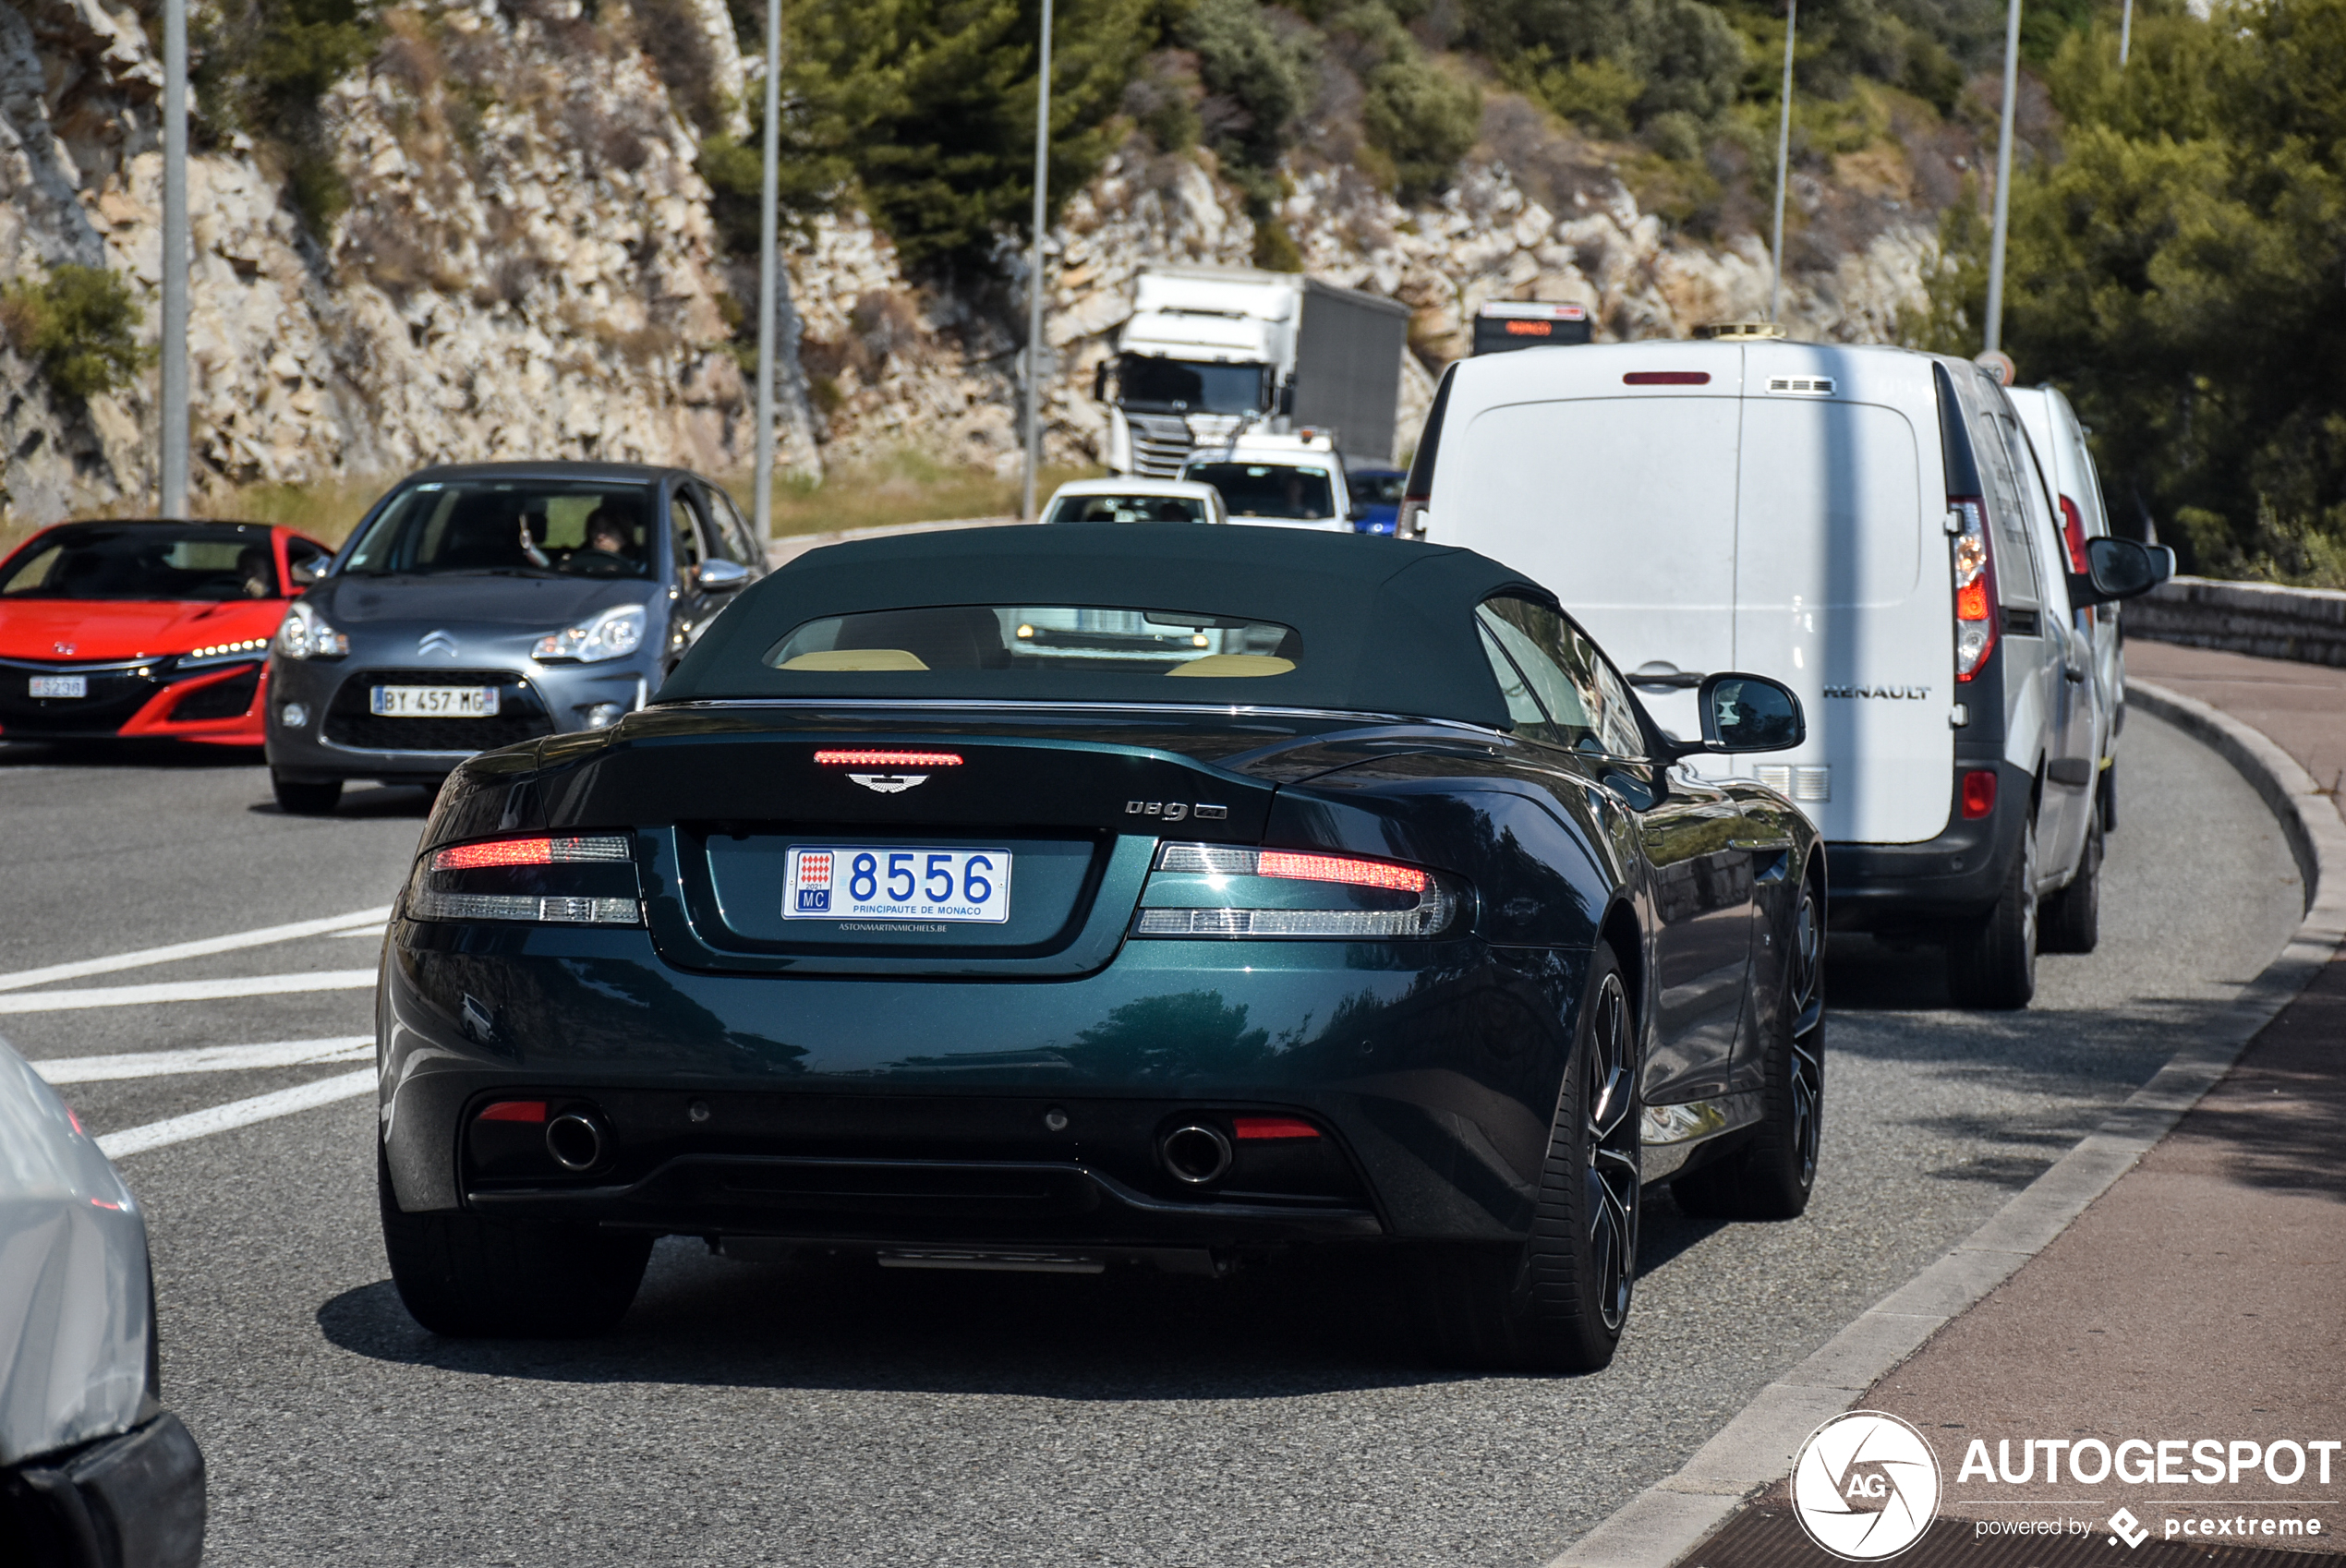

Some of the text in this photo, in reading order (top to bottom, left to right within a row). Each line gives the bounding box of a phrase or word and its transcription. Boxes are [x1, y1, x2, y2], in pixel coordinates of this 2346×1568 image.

[1822, 684, 1931, 700] RENAULT
[1124, 801, 1189, 821] DB9
[849, 852, 994, 904] 8556
[803, 892, 825, 907] MC
[853, 905, 982, 915] PRINCIPAUTE DE MONACO
[839, 923, 948, 933] ASTONMARTINMICHIELS.BE
